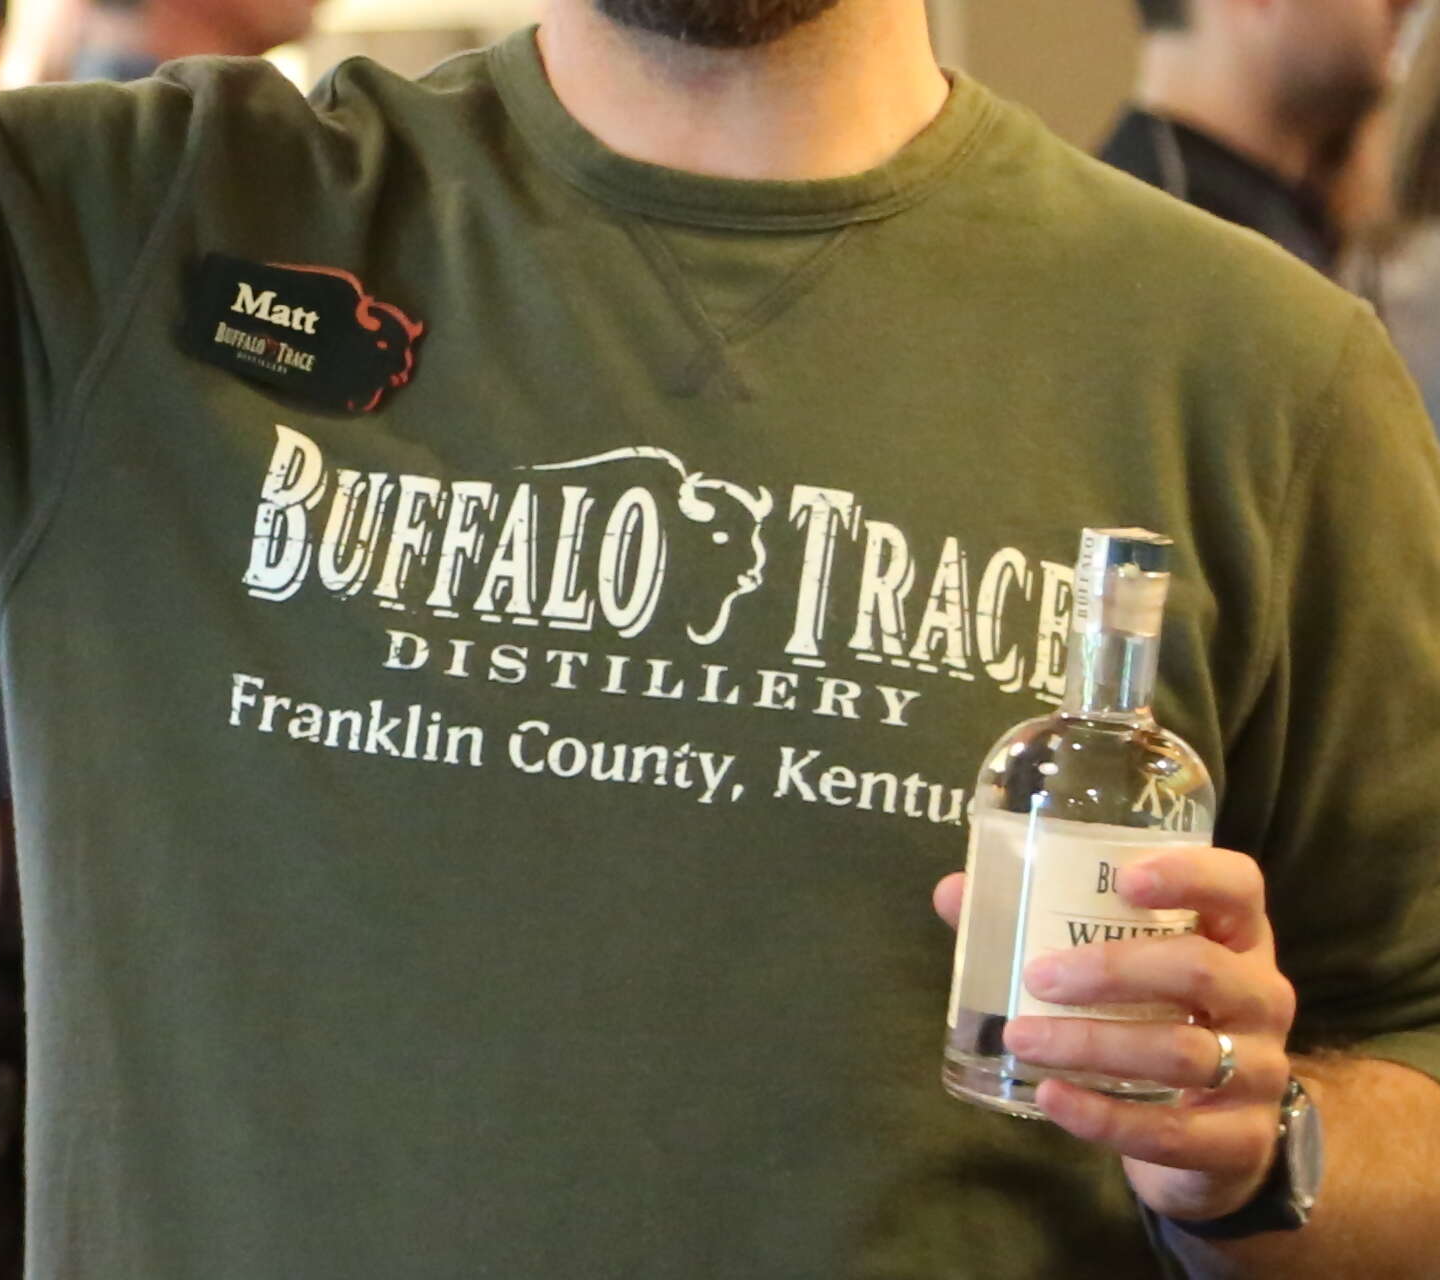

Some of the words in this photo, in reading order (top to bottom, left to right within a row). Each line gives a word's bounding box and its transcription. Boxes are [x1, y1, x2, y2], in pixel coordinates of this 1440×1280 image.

[230, 281, 321, 335] Matt
[240, 423, 668, 639] BUFFALO
[783, 484, 1077, 706] TRACE
[381, 628, 921, 727] DISTILLERY
[228, 672, 484, 768] Franklin
[508, 719, 744, 805] County,
[772, 746, 978, 827] Kentu
